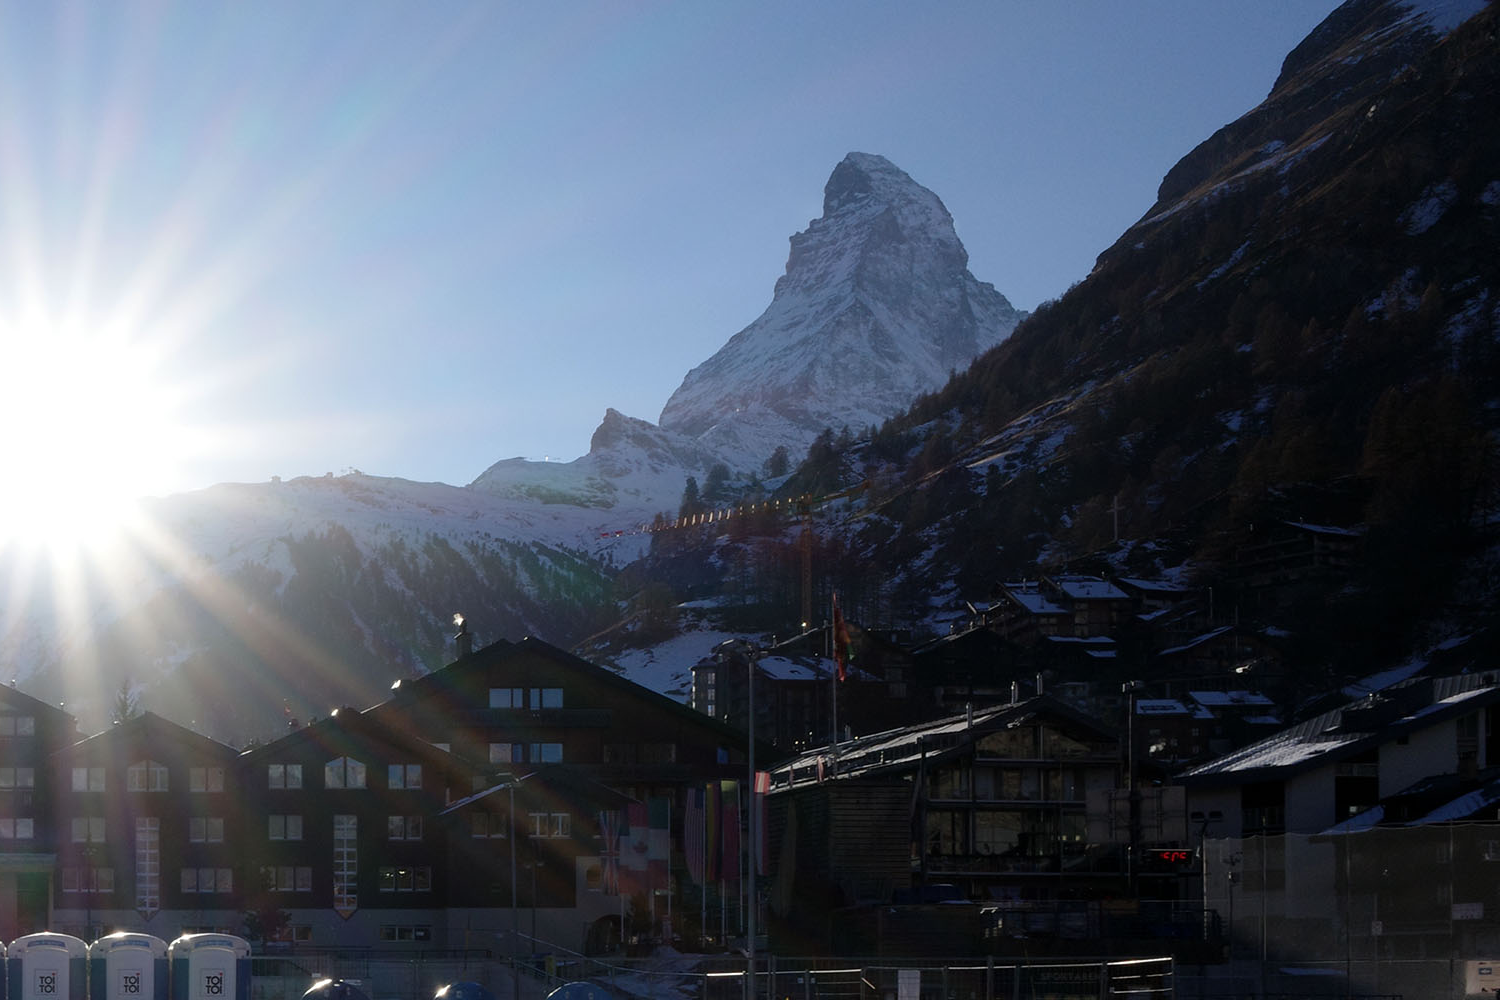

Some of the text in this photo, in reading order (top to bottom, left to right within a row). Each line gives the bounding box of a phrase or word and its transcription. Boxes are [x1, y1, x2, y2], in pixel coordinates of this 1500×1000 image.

[40, 985, 56, 994] TOI
[124, 985, 140, 994] TOI
[206, 985, 223, 994] TOI
